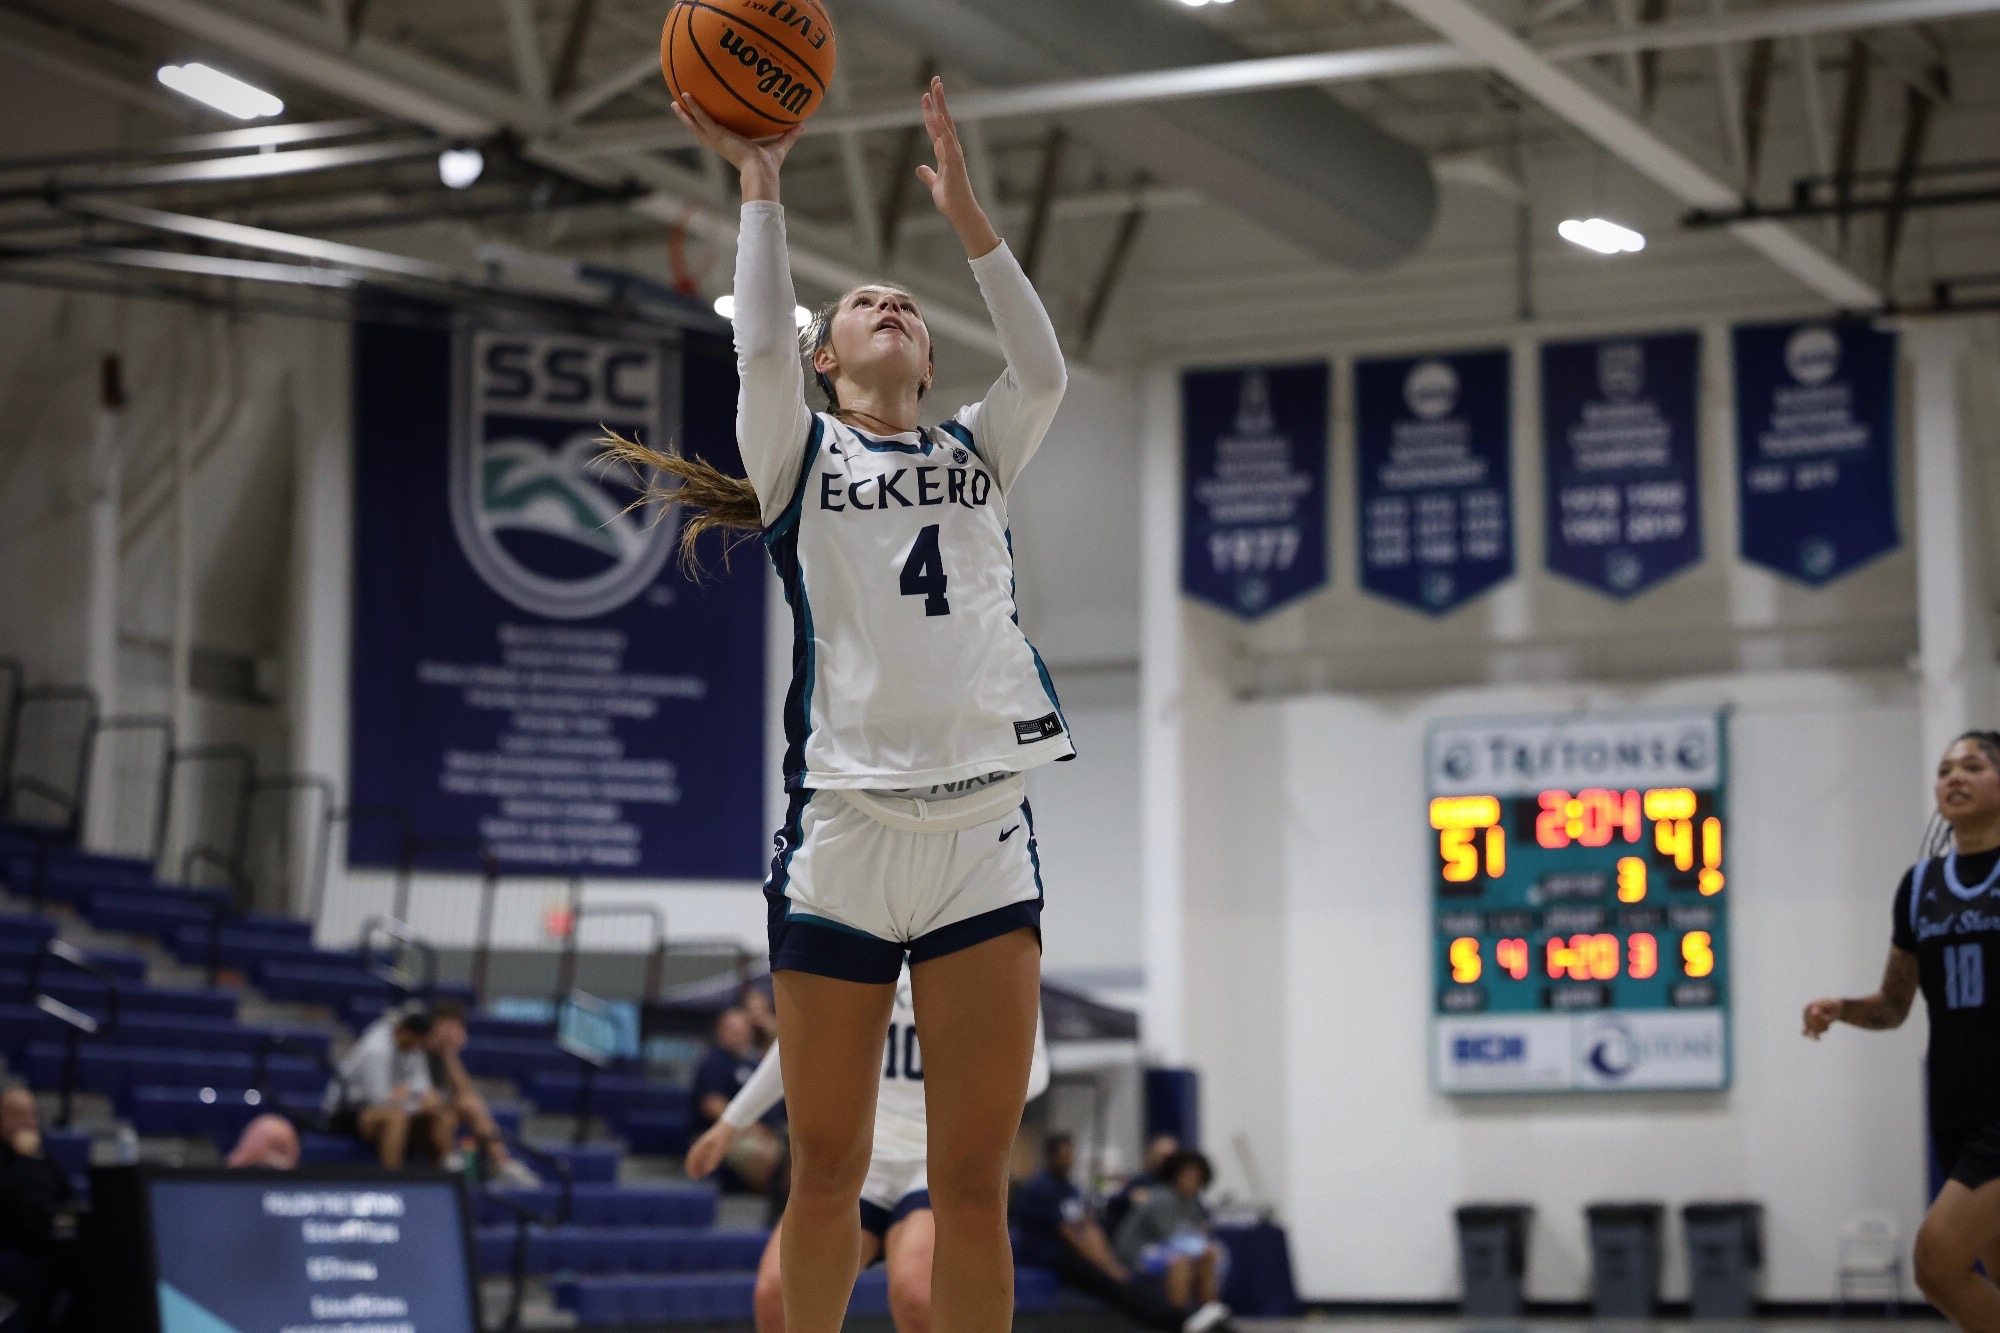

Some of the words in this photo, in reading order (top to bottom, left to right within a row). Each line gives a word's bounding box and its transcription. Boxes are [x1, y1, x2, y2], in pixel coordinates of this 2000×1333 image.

[768, 0, 827, 50] EVO
[719, 27, 813, 116] Wilson
[483, 343, 649, 409] SSC
[820, 466, 991, 512] ECKERD
[900, 523, 950, 616] 4
[1044, 720, 1055, 730] M
[1536, 788, 1642, 849] 2:04
[1440, 823, 1506, 882] 51
[1616, 856, 1648, 903] 3
[1450, 936, 1482, 984] 5
[1681, 930, 1714, 978] 5
[1943, 942, 1985, 1010] 10
[885, 1022, 925, 1080] 10
